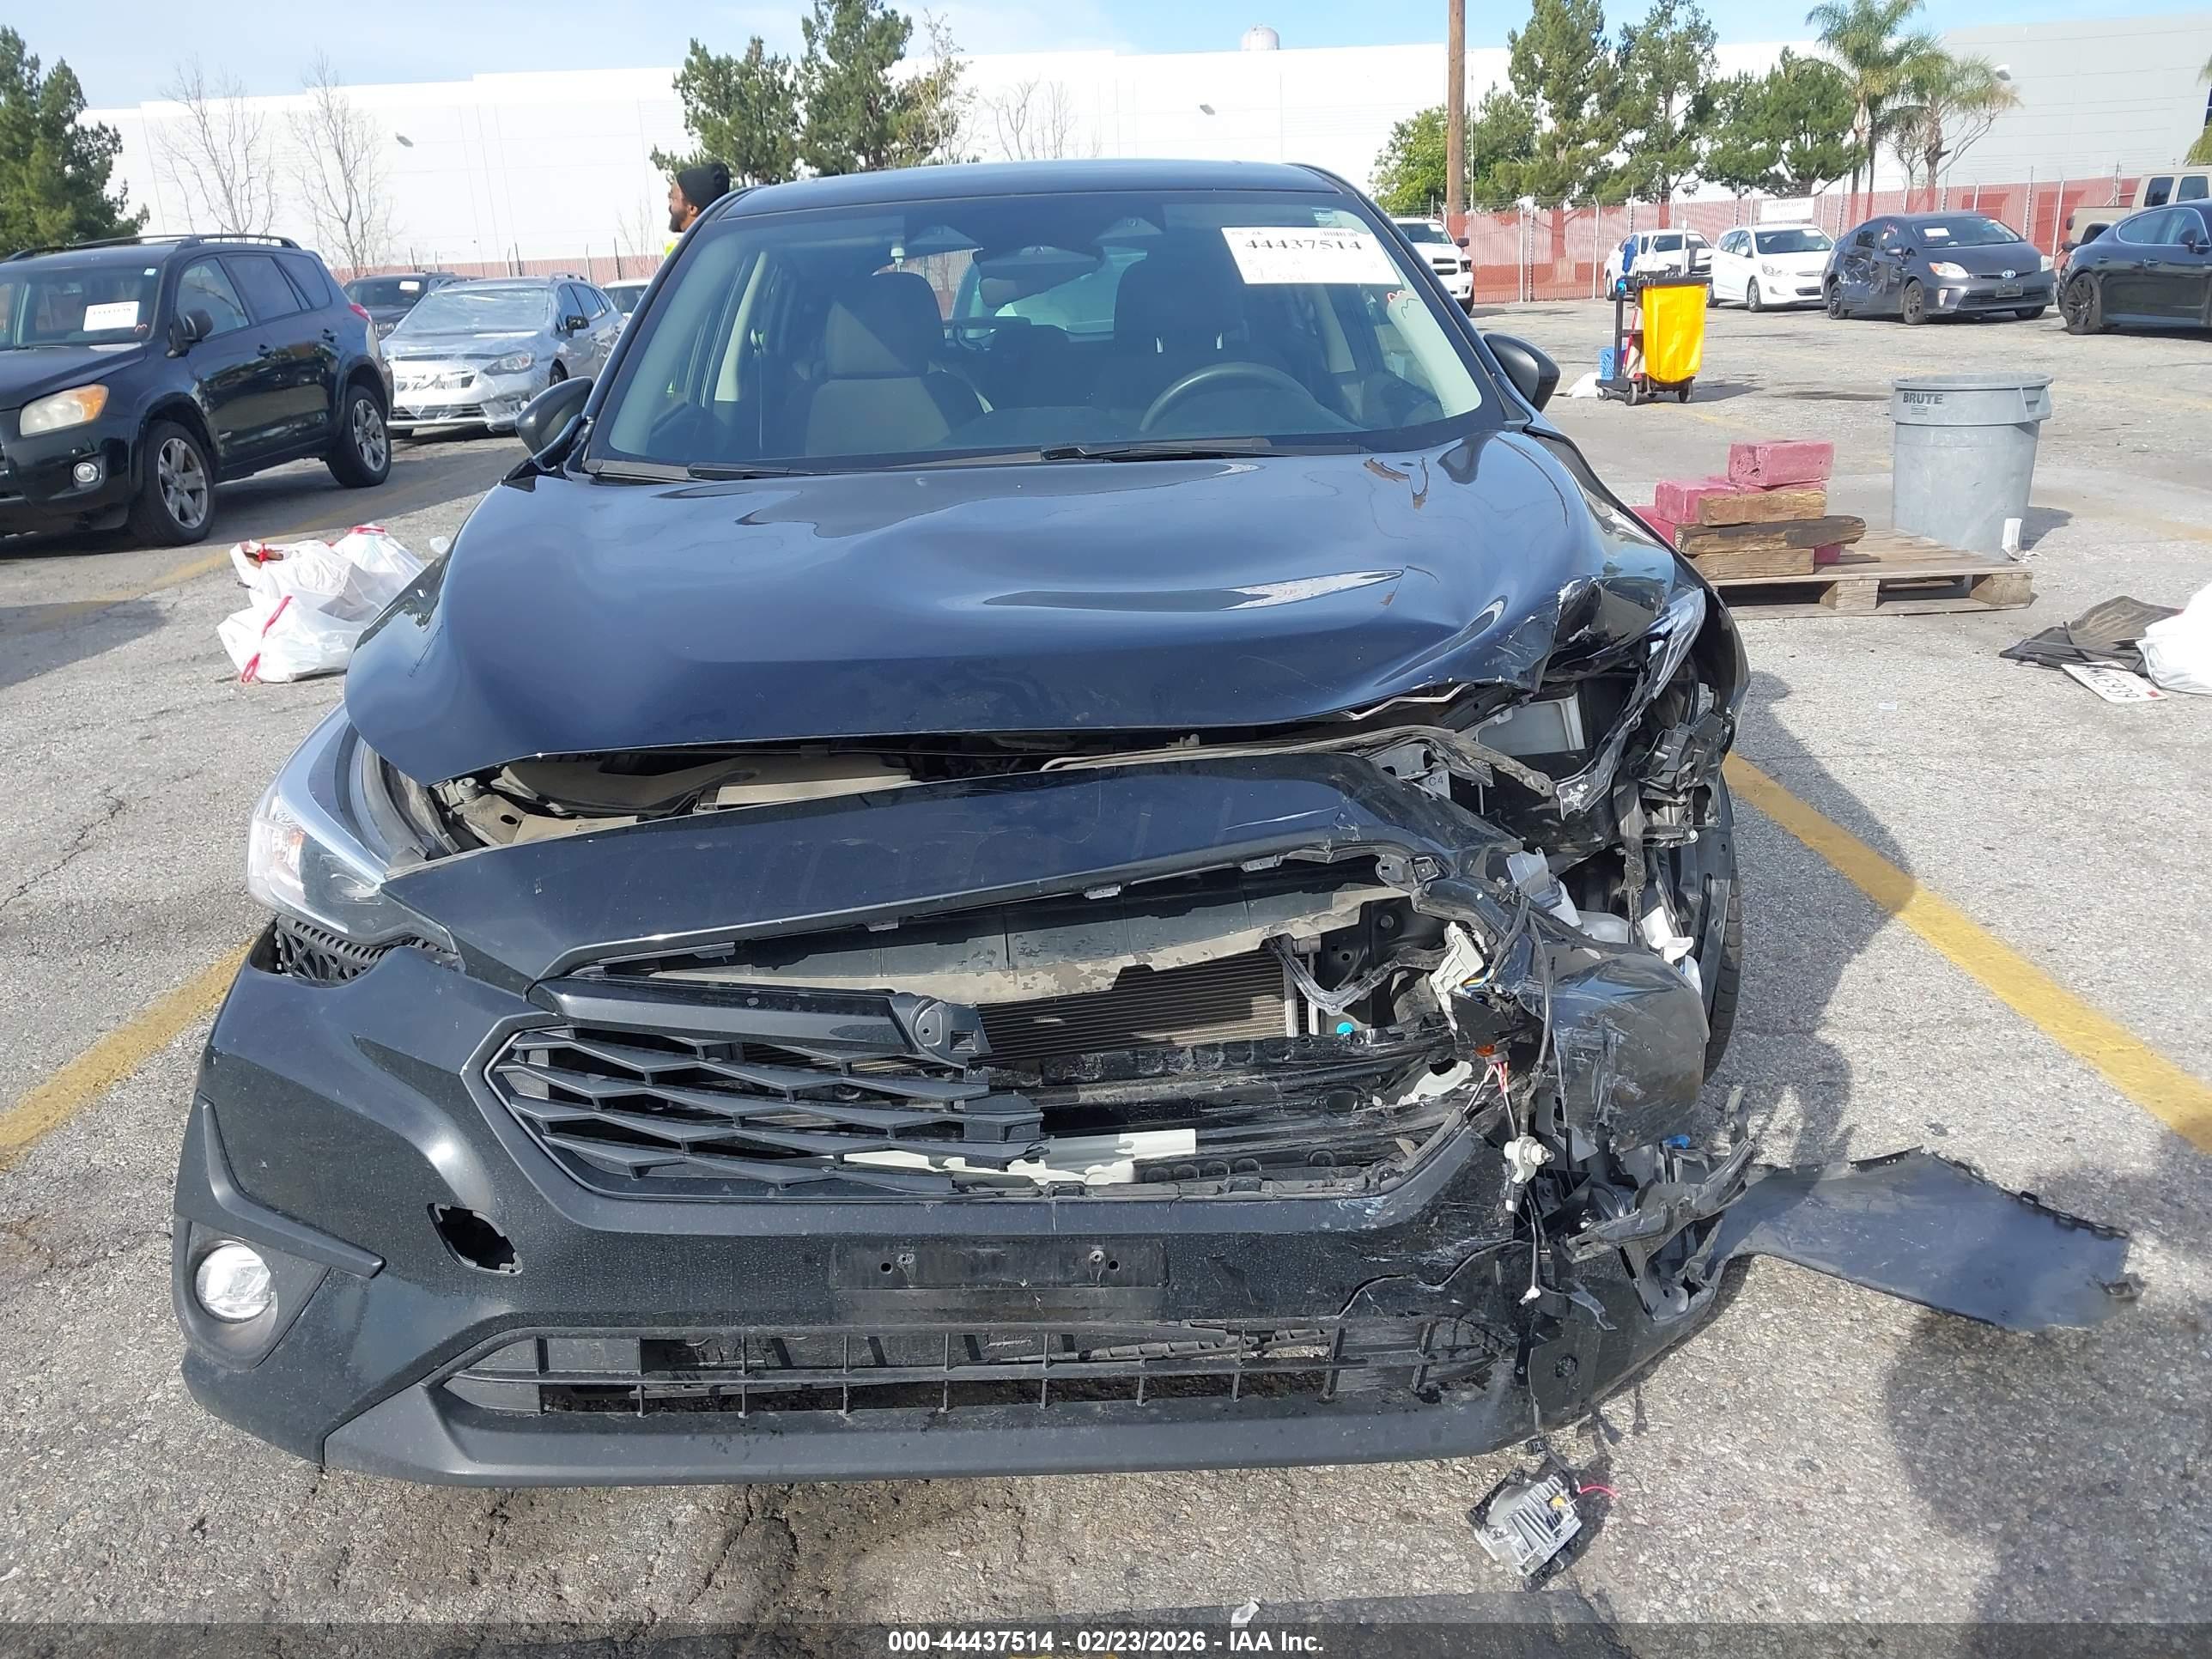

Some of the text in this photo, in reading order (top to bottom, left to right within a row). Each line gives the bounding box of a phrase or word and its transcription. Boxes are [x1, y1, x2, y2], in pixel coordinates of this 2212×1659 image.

[1244, 239, 1364, 251] 44437514
[1902, 392, 1944, 405] BRUTE
[1428, 775, 1444, 787] C4
